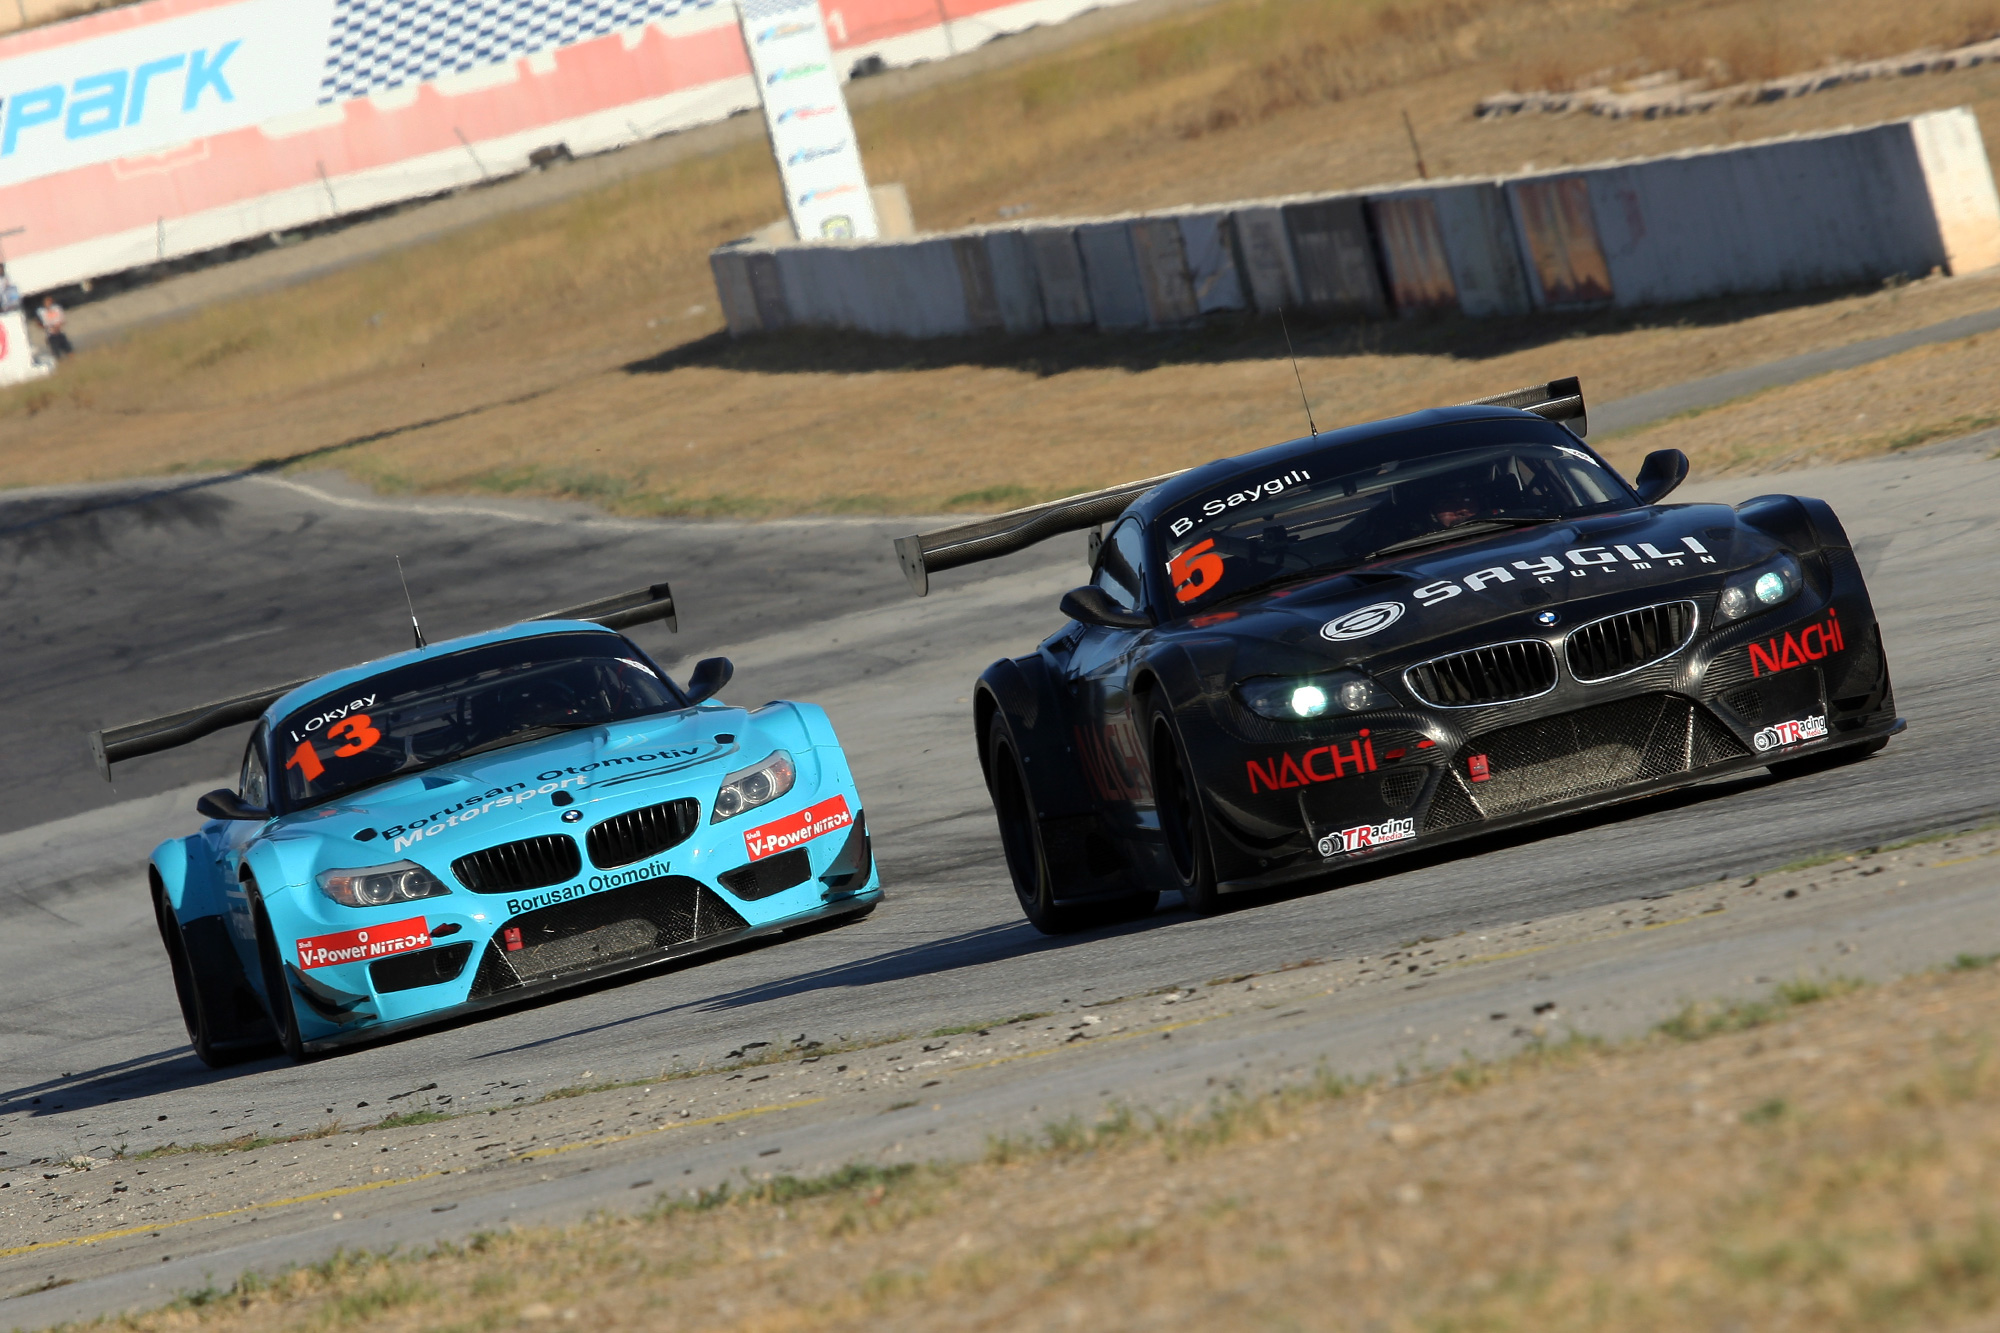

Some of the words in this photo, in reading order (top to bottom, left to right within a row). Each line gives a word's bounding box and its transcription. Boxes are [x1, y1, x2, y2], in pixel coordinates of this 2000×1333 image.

[1169, 537, 1225, 603] 5
[1775, 717, 1826, 744] TRacing
[285, 713, 382, 782] 13
[381, 781, 527, 841] Borusan
[536, 746, 700, 782] Otomotiv
[393, 774, 588, 854] Motorsport
[746, 830, 761, 841] Shell
[748, 825, 813, 857] V-Power
[1342, 818, 1414, 850] TRacing
[506, 883, 586, 916] Borusan
[588, 860, 672, 892] Otomotiv
[298, 940, 313, 949] Shell
[300, 945, 368, 967] V-Power
